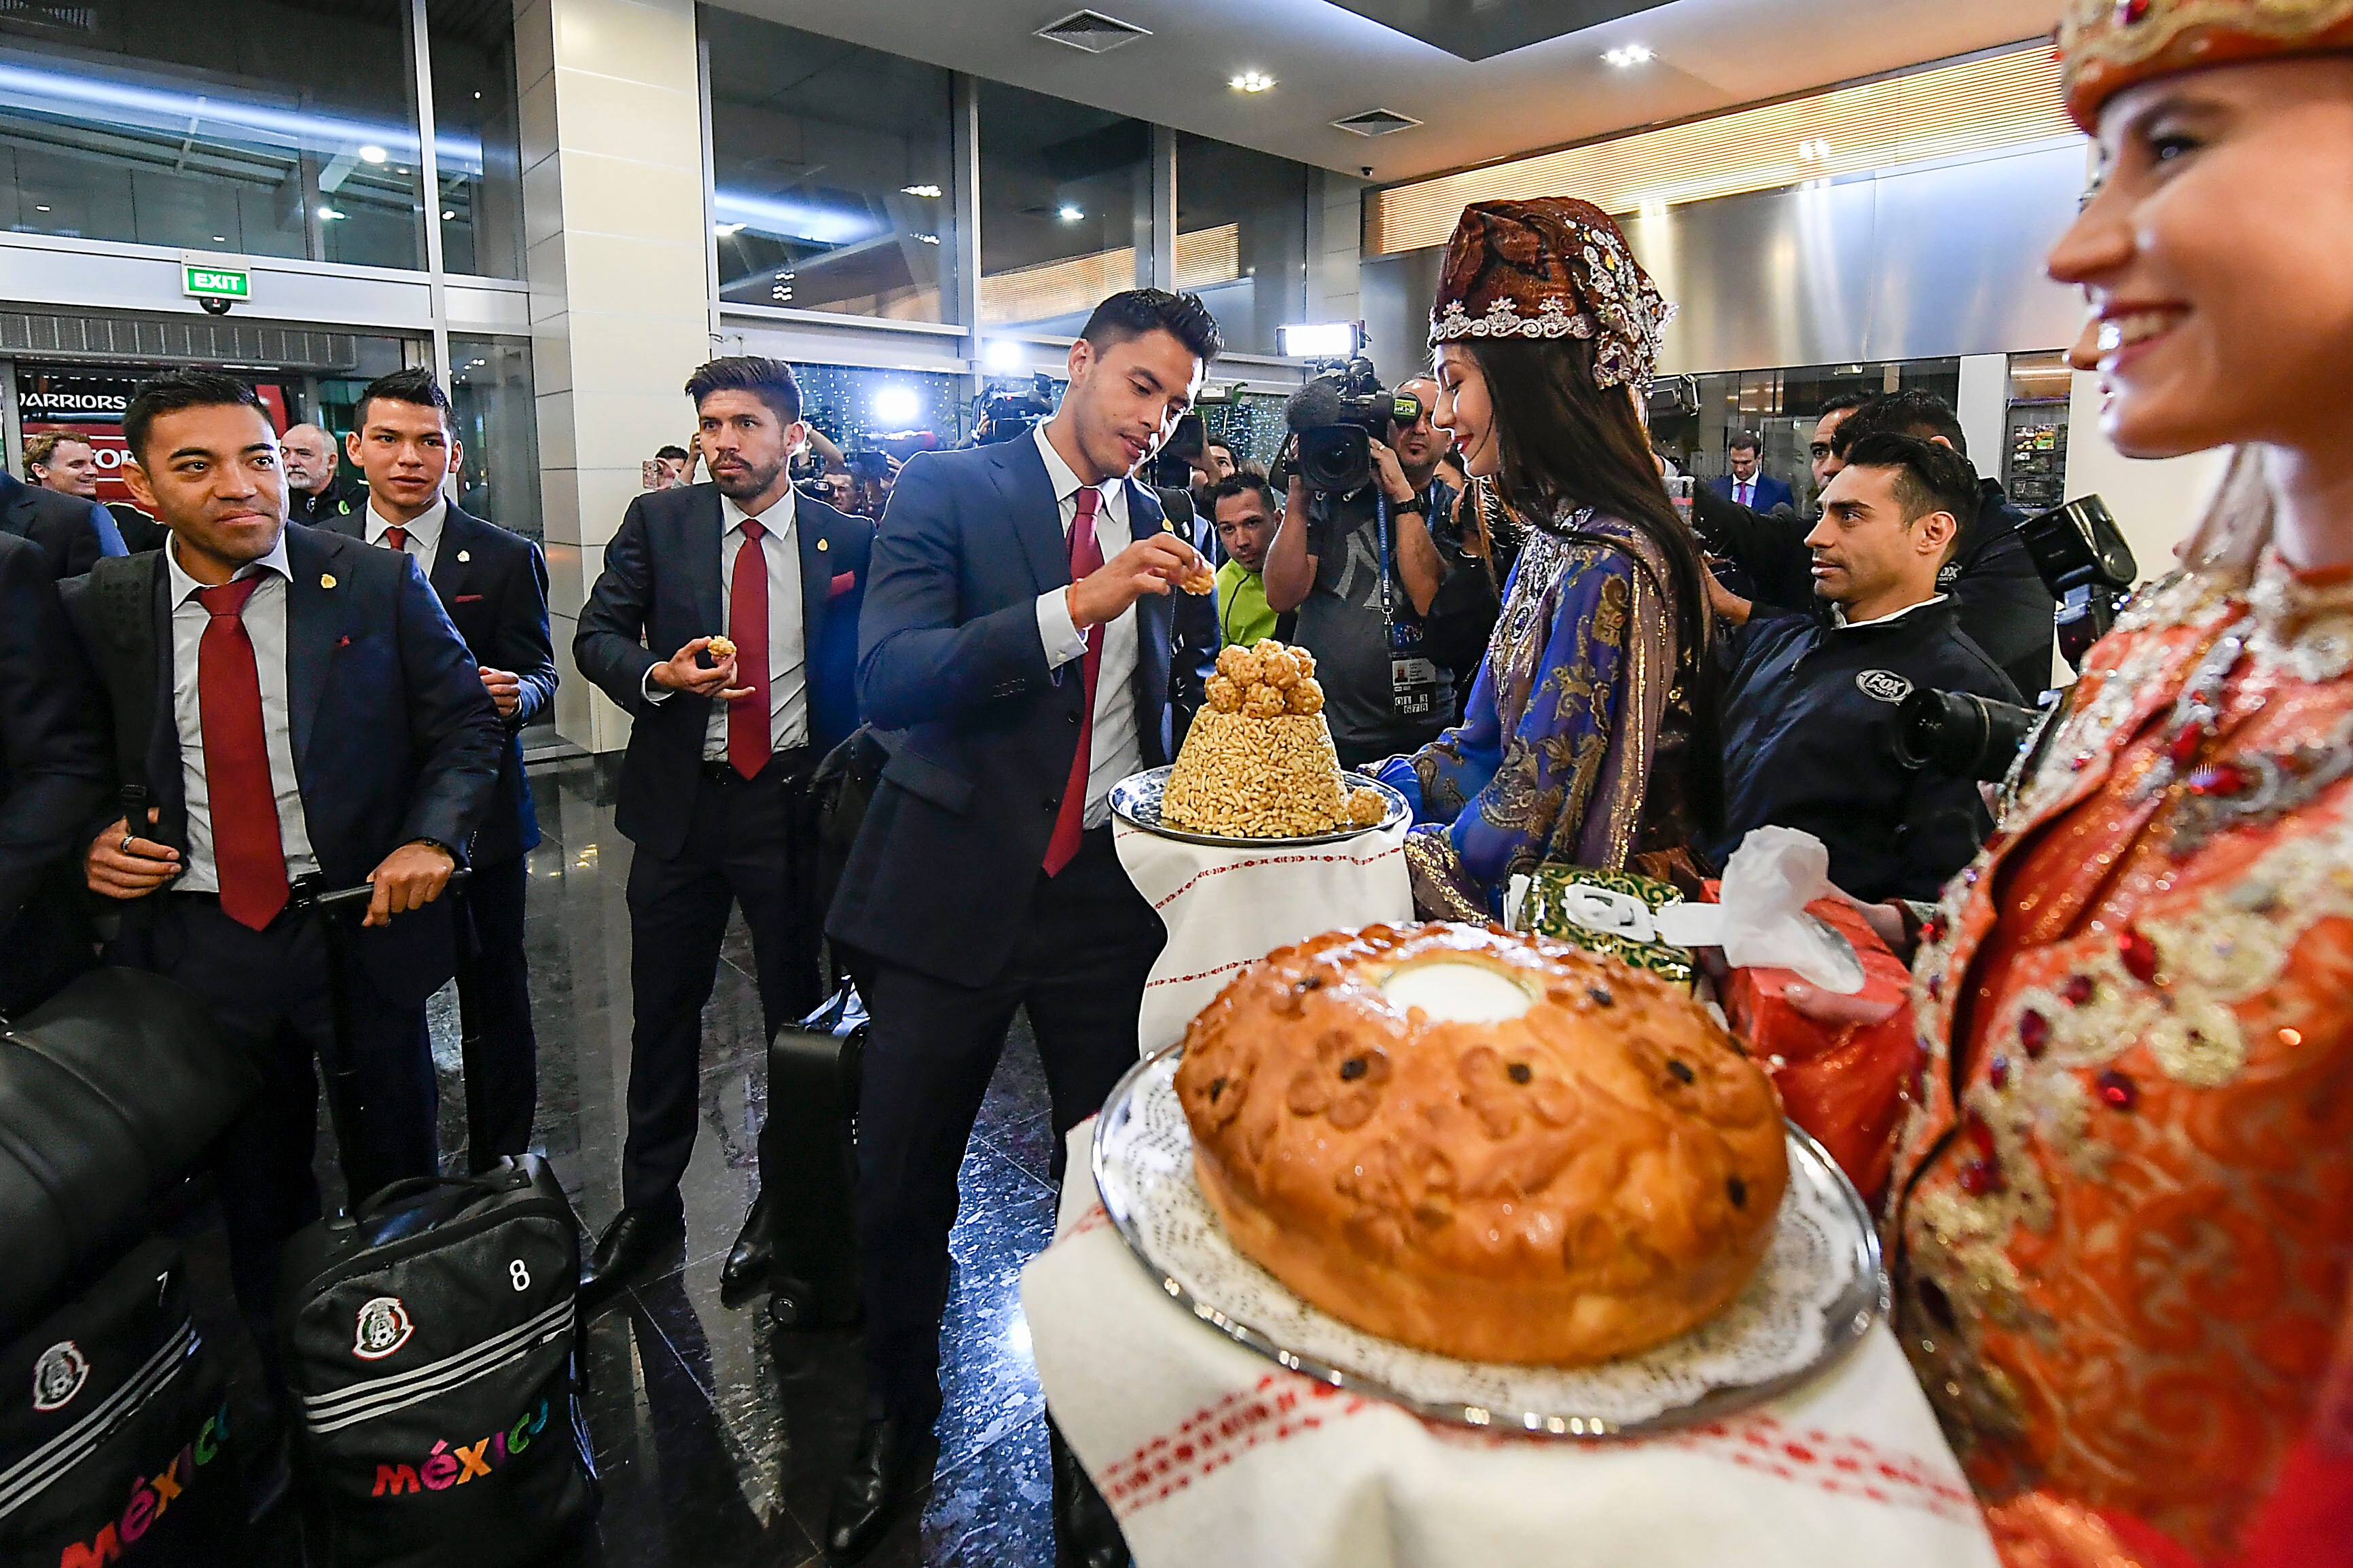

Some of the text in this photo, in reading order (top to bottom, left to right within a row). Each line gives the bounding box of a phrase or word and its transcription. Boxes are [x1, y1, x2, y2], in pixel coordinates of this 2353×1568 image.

[194, 272, 240, 291] EXIT
[1939, 566, 1959, 578] OX
[1865, 682, 1896, 698] SPORTS
[1868, 673, 1905, 694] FOX
[509, 1259, 531, 1292] 8
